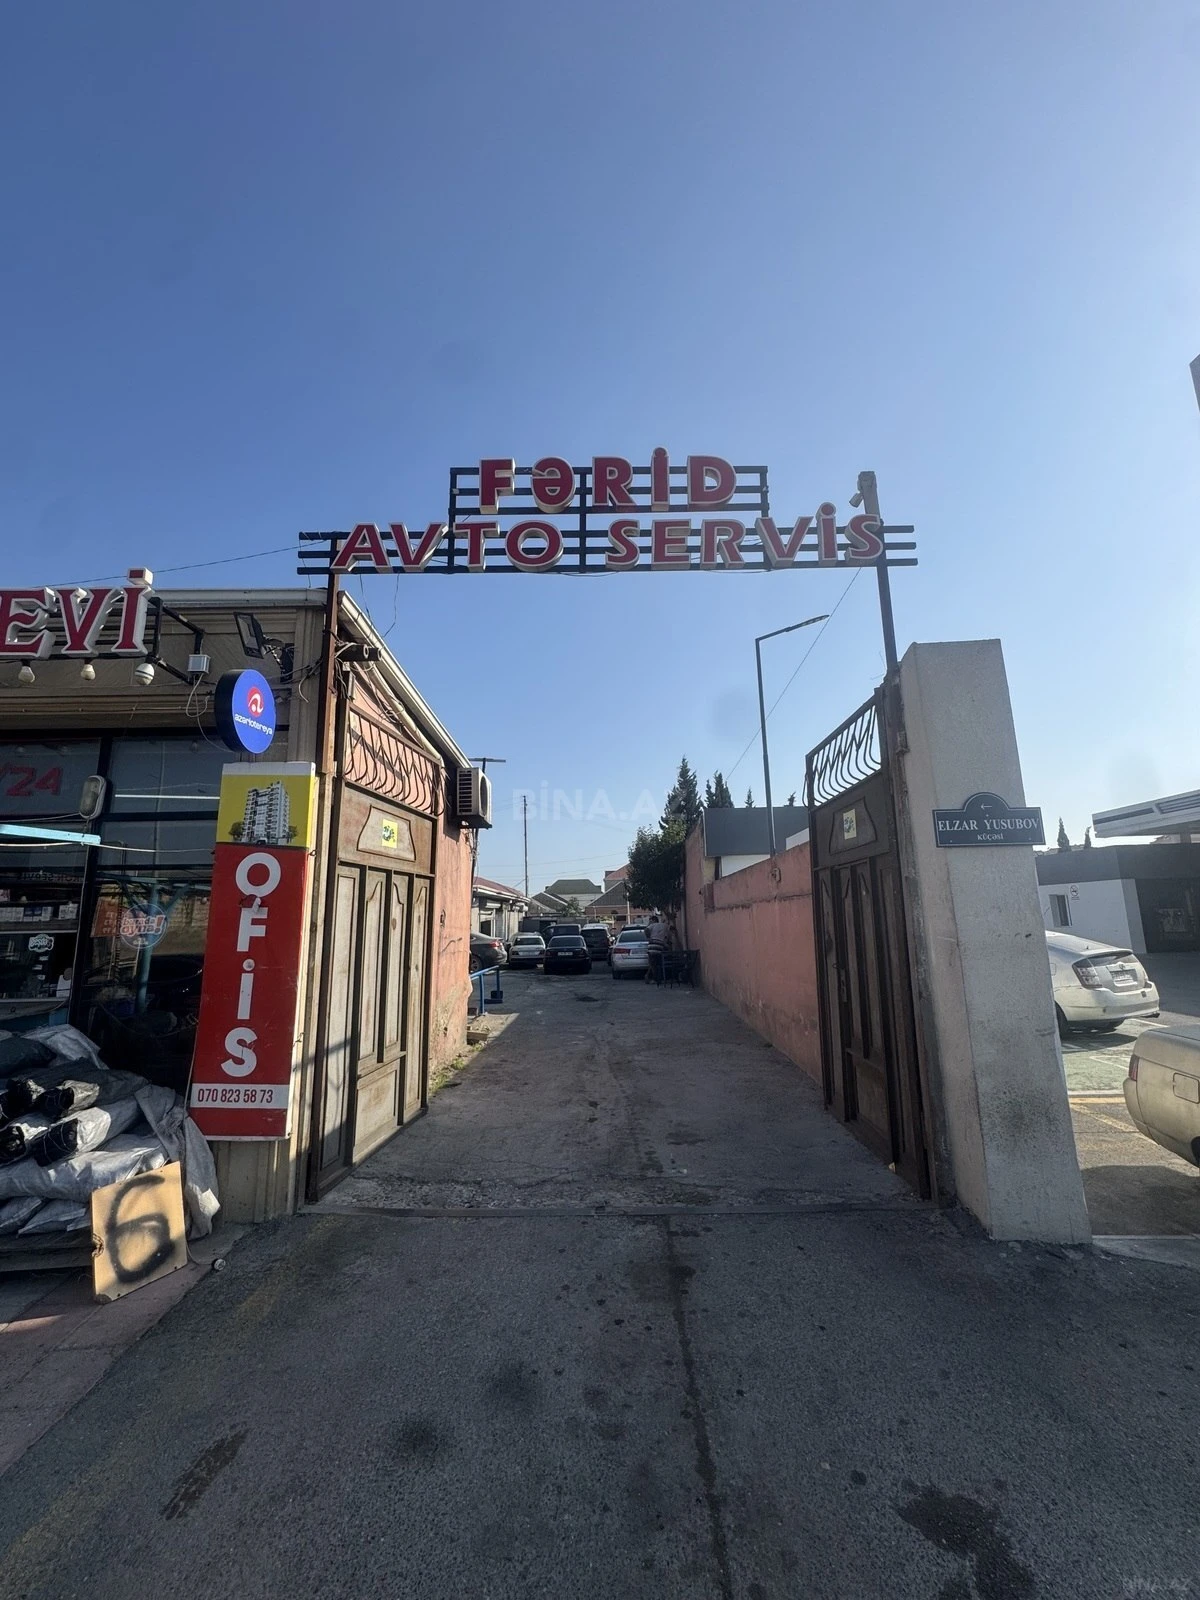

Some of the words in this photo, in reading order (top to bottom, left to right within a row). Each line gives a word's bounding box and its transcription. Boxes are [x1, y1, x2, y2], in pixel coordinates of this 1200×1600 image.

[479, 447, 737, 514] FƏRİD
[330, 520, 564, 572] AVTO
[605, 502, 883, 570] SERVİS
[0, 567, 155, 659] EVİ
[938, 820, 979, 831] ELZAR
[983, 818, 1039, 830] YUSUBOV
[198, 1088, 219, 1102] 070
[220, 1089, 241, 1103] 823
[243, 1089, 257, 1103] 58
[260, 1089, 274, 1103] 73
[105, 1174, 175, 1283] 6
